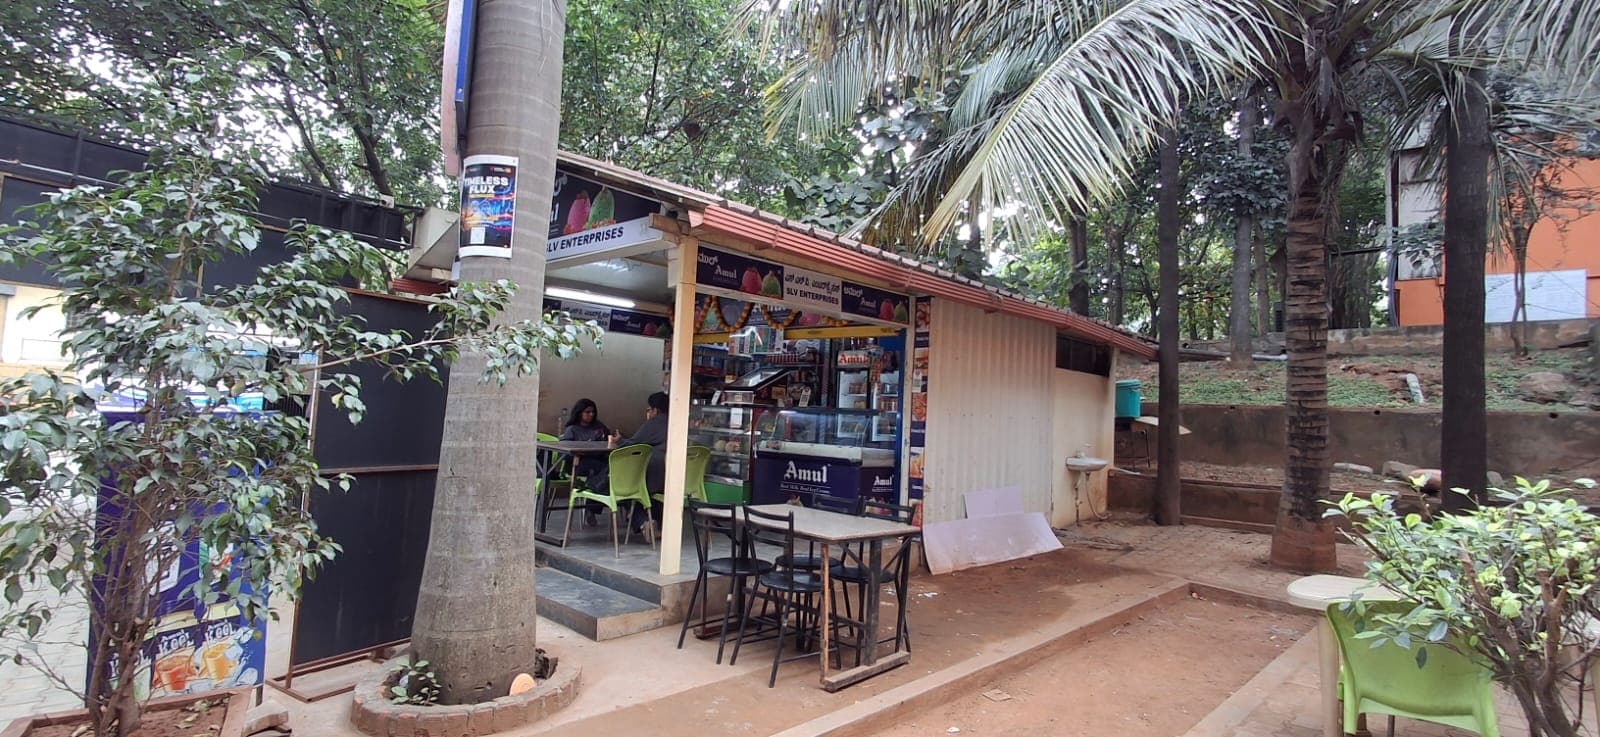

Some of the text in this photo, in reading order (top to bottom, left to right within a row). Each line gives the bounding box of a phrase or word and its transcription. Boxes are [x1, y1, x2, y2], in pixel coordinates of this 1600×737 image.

[462, 175, 509, 186] TIMELESS
[469, 184, 496, 194] FLUX
[560, 226, 625, 250] ENTERPRISES
[714, 264, 738, 279] Amul
[786, 287, 839, 305] SLV ENTERPRISES
[839, 353, 869, 364] Amul
[784, 460, 829, 484] Amul
[873, 475, 892, 486] Amul
